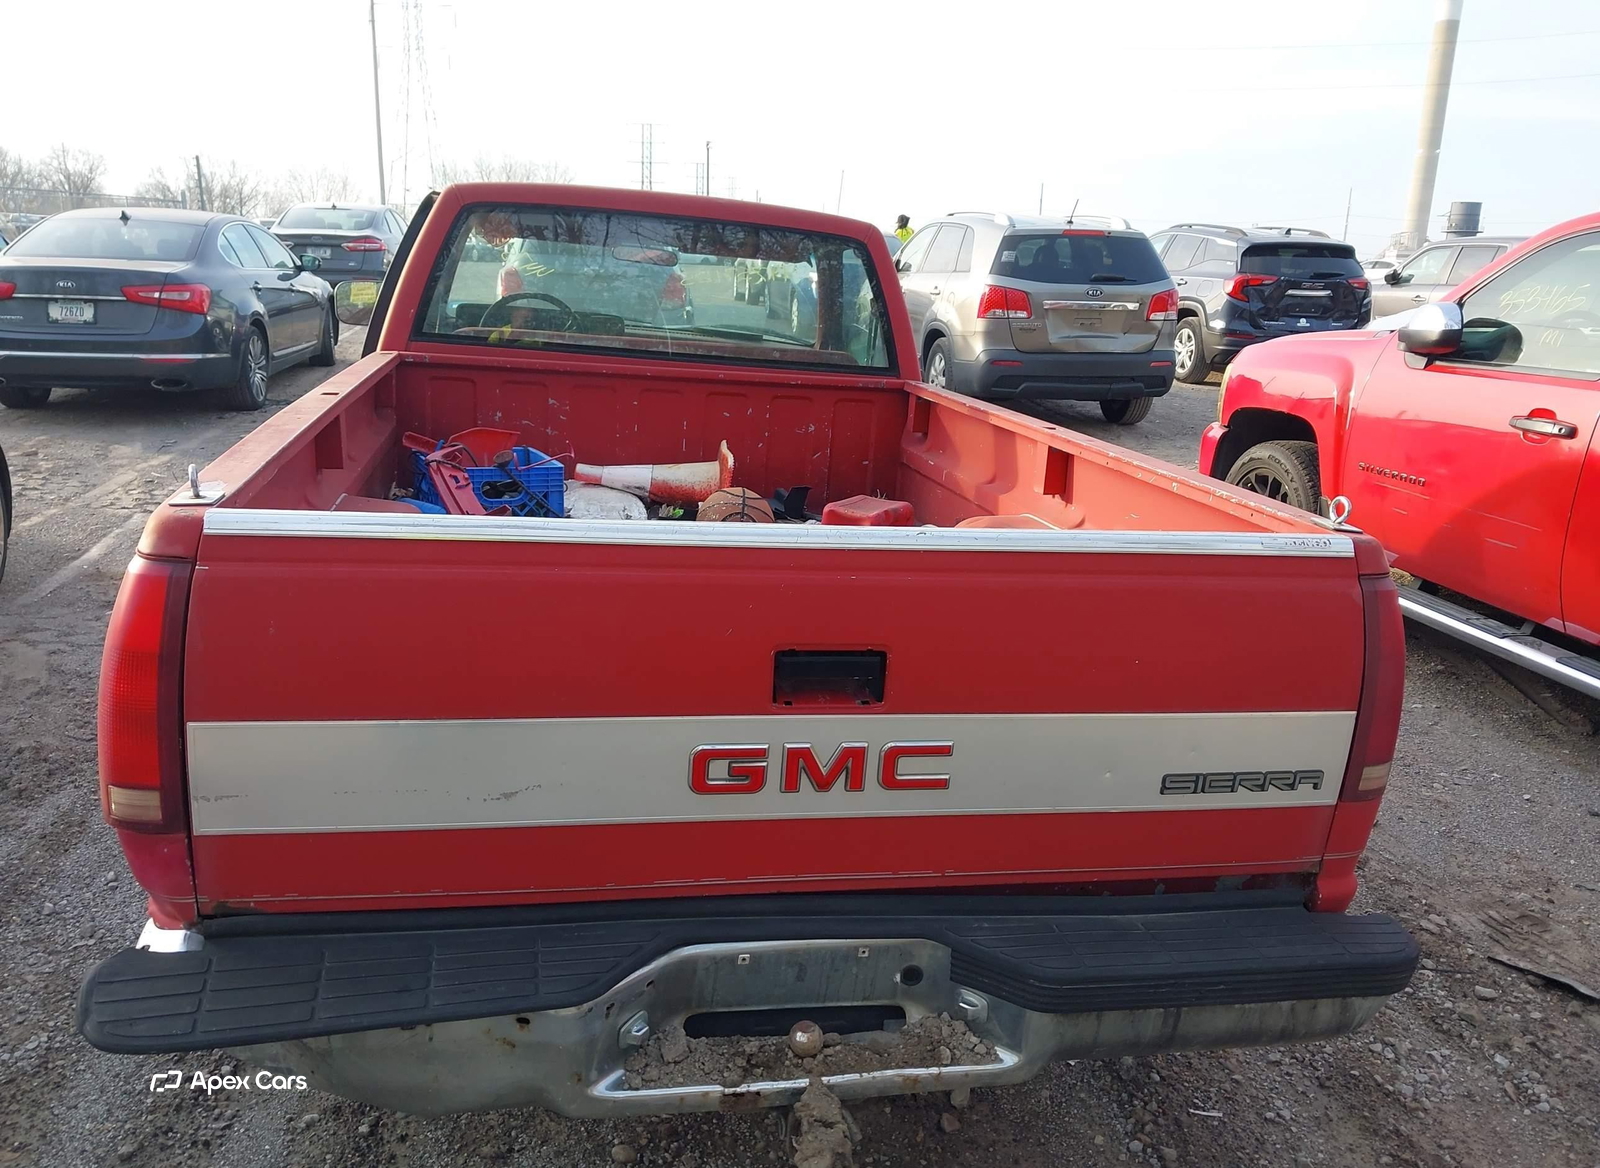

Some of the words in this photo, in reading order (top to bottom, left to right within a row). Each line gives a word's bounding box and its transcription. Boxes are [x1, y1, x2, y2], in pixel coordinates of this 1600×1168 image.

[1087, 289, 1102, 297] KIA
[1267, 454, 1297, 484] ROCKY
[1358, 461, 1426, 487] SILVERADO
[687, 740, 954, 795] GMC
[1160, 769, 1325, 795] SIERRA
